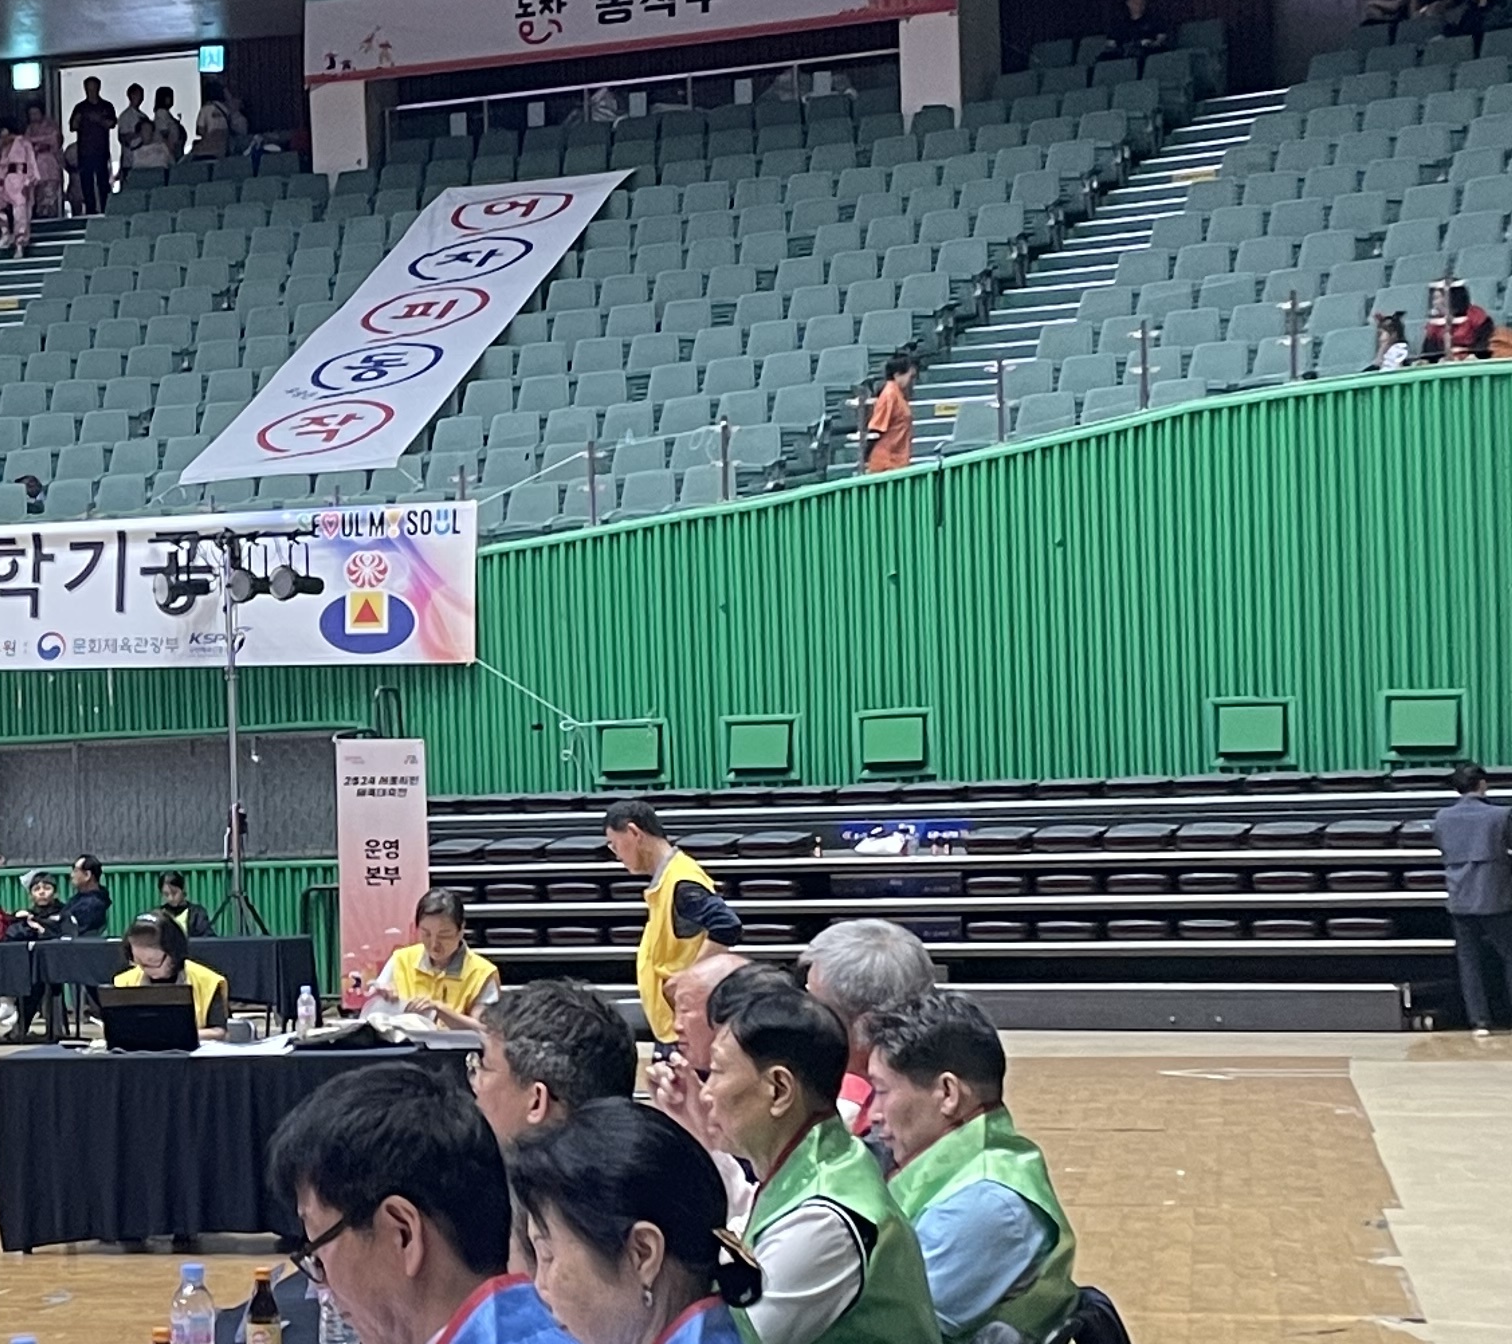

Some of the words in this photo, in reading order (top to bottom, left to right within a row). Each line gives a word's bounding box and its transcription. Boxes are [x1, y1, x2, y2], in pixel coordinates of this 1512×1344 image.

[406, 508, 461, 536] SOUL
[364, 838, 400, 860] 운영
[364, 866, 402, 887] 본부
